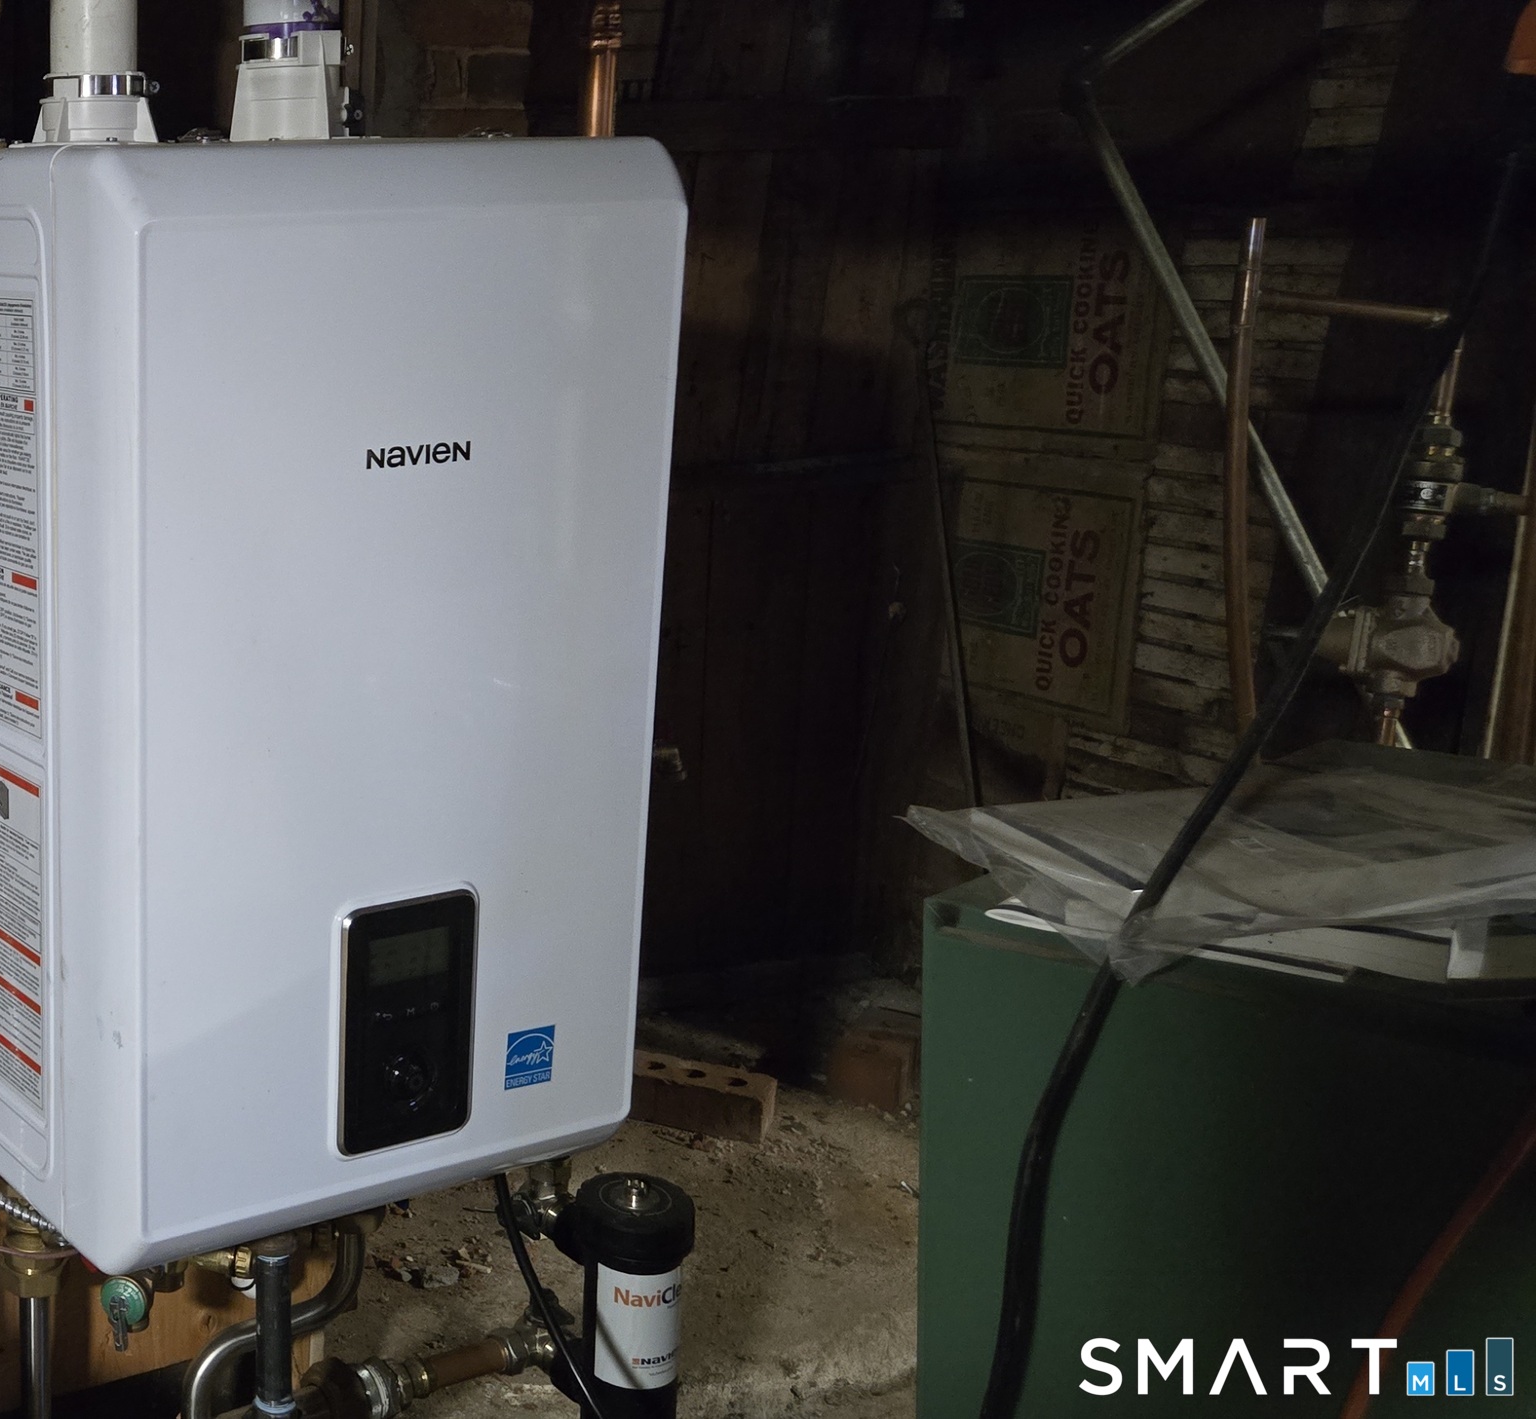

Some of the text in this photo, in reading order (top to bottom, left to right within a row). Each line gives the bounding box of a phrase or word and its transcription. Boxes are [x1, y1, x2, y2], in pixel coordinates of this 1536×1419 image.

[1088, 250, 1130, 395] OATS
[1065, 348, 1087, 425] QUICK
[1059, 529, 1101, 668] OATS
[1034, 618, 1056, 691] QUICK
[506, 1071, 551, 1088] ENERGY STAR
